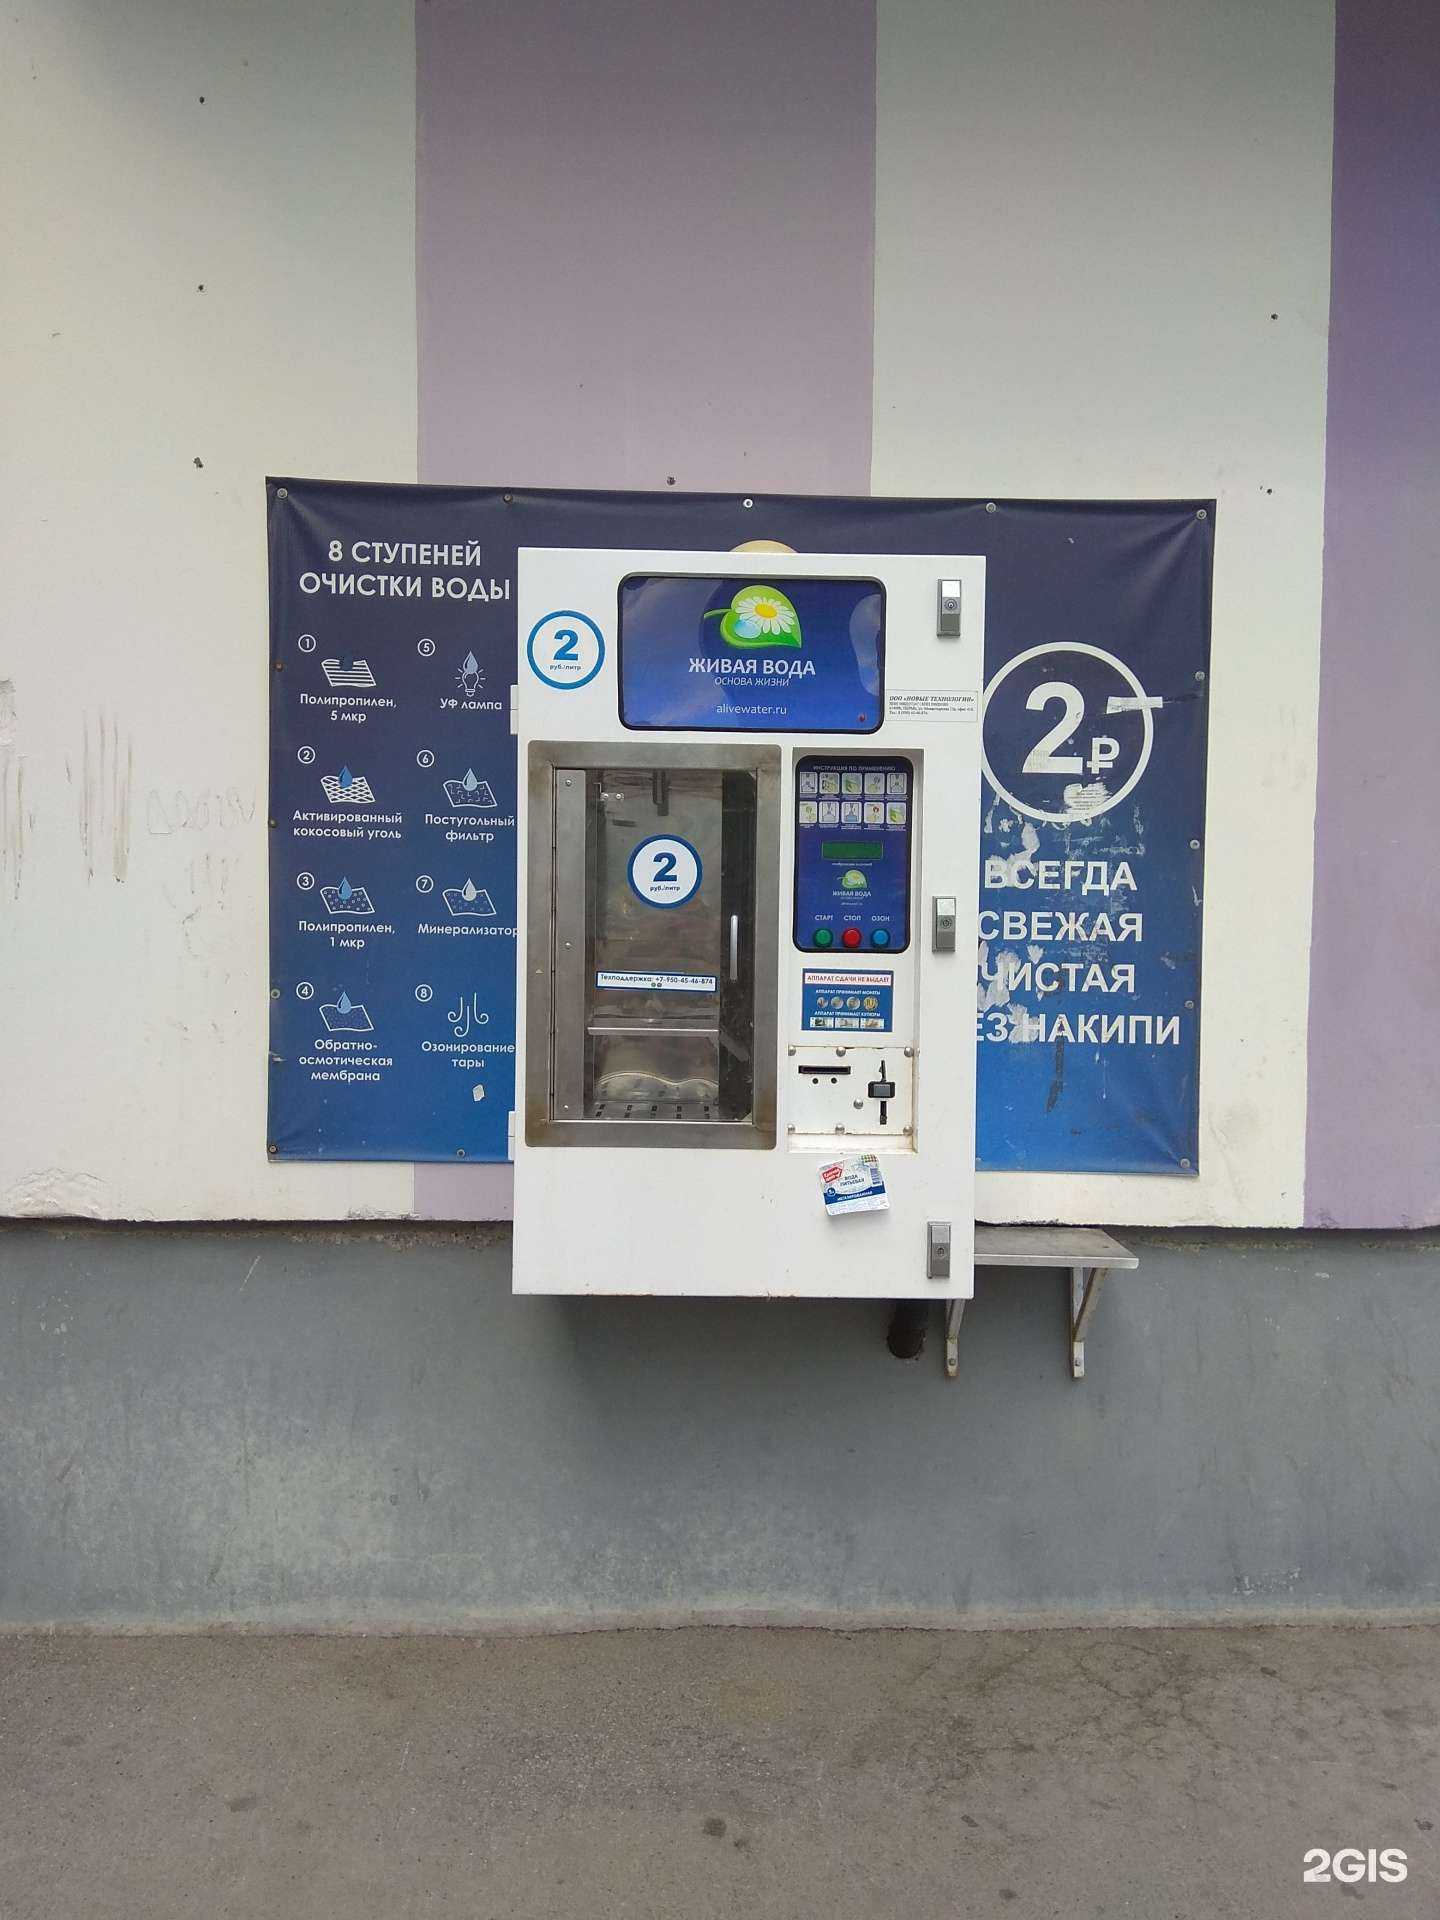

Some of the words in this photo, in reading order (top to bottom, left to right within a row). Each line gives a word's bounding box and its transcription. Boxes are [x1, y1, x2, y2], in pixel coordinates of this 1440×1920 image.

[328, 540, 343, 562] 8
[352, 540, 482, 566] СТУПЕНЕЙ
[299, 572, 423, 597] ОЧИСТКИ
[432, 577, 511, 601] ВОДЫ
[553, 629, 579, 661] 2
[688, 658, 757, 674] ЖИВАЯ
[763, 660, 816, 679] ВОДА
[714, 676, 753, 686] ОСНОВА
[754, 677, 790, 687] ЖИЗНИ
[300, 694, 397, 709] Полипропилен,
[440, 698, 458, 711] УФ
[461, 699, 502, 711] лампа
[716, 703, 787, 715] alivewater.ru
[331, 711, 338, 721] 5
[341, 713, 367, 724] мкр
[1022, 682, 1085, 775] 2
[293, 811, 403, 827] Активированный
[425, 814, 515, 829] Постугольный
[293, 827, 364, 839] кокосовый
[368, 830, 402, 841] уголь
[446, 830, 495, 844] фильтр
[653, 852, 678, 882] 2
[984, 860, 1138, 895] ВСЕГДА
[298, 920, 396, 936] Полипропилен,
[417, 923, 519, 937] Минерализатор
[978, 911, 1143, 942] СВЕЖАЯ
[329, 937, 335, 948] 1
[339, 939, 366, 950] мкр
[980, 962, 1135, 993] ЧИСТАЯ
[1024, 1014, 1181, 1046] НАКИПИ
[314, 1039, 378, 1051] Обратно-
[421, 1041, 515, 1054] Озонирование
[299, 1056, 393, 1067] осмотическая
[451, 1058, 485, 1069] тары
[311, 1069, 381, 1083] мембрана
